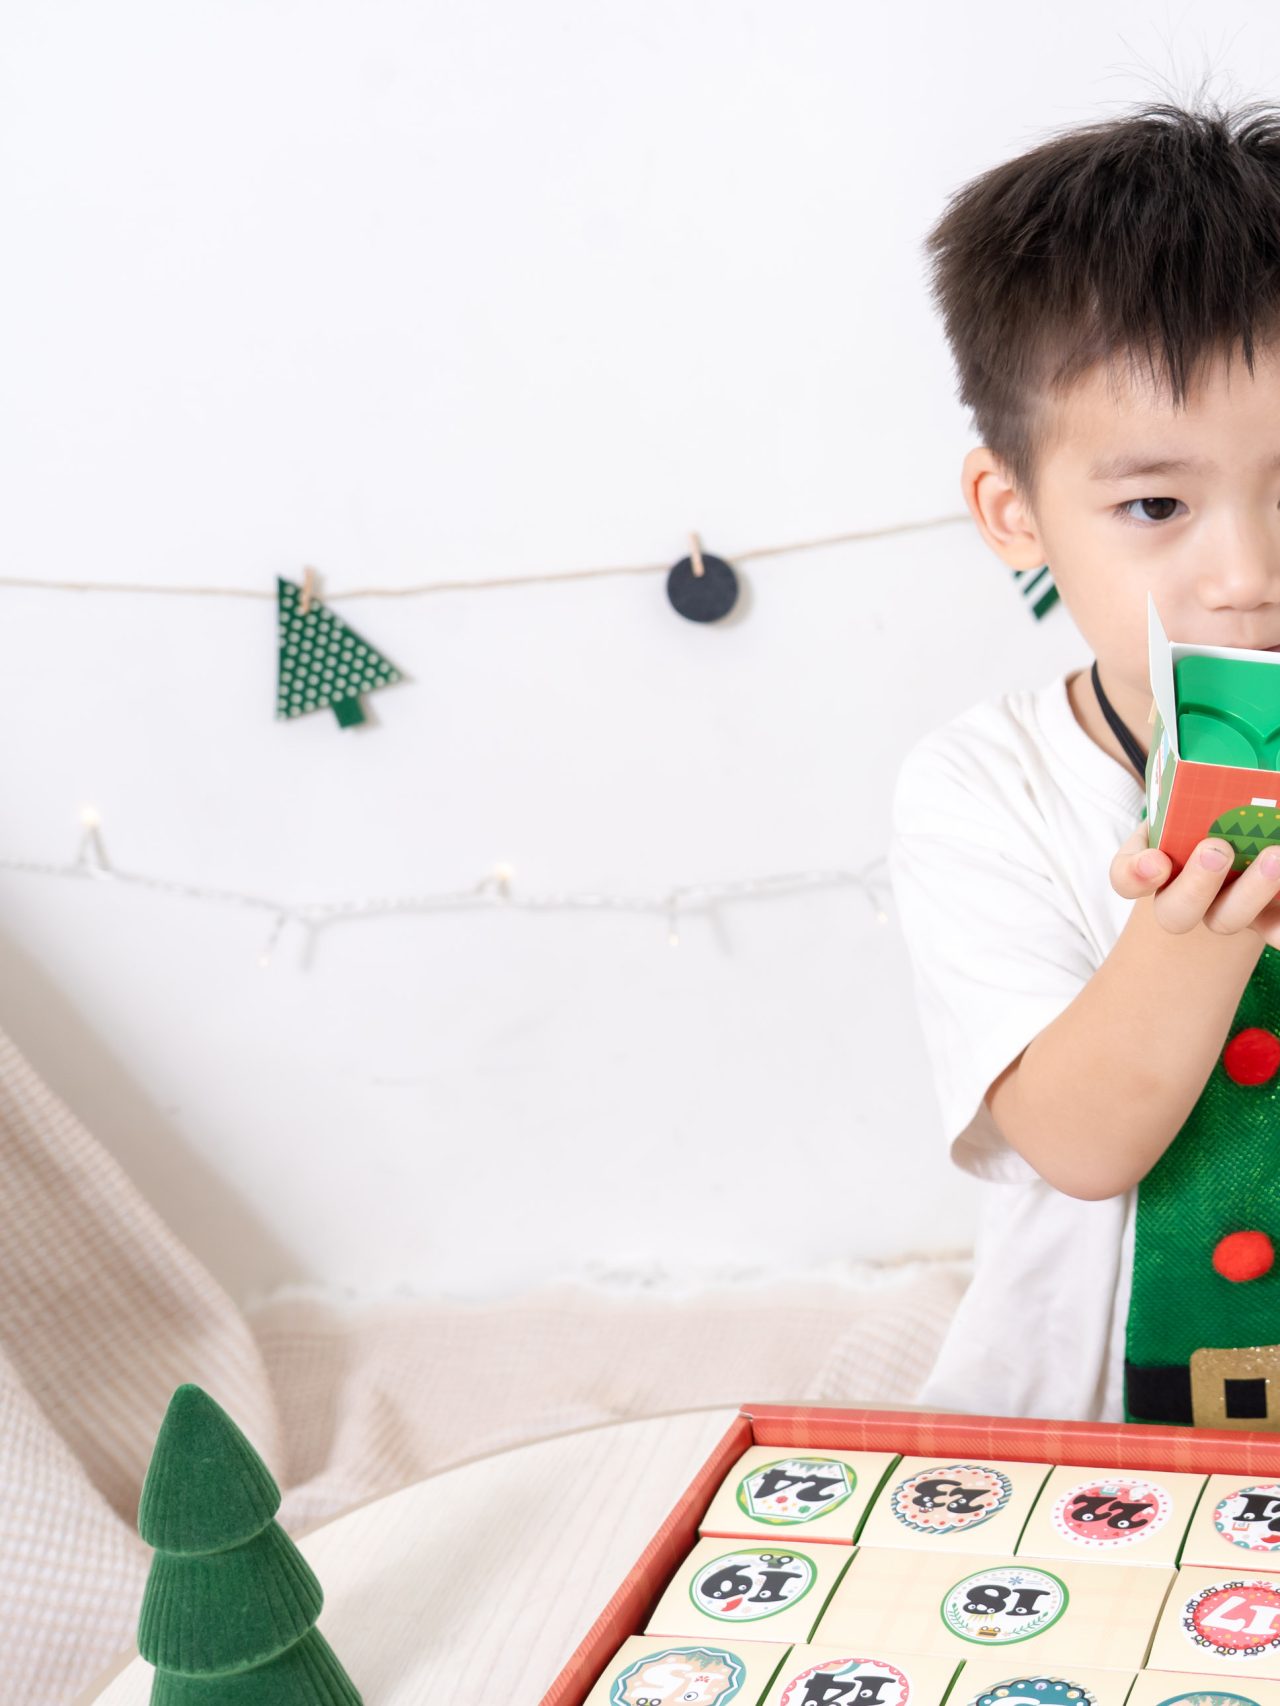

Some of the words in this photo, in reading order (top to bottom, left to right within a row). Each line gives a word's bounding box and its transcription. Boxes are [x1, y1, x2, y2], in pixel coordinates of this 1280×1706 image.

[754, 1469, 845, 1502] 24
[912, 1479, 992, 1514] 23
[1072, 1494, 1153, 1529] 22
[700, 1564, 802, 1603] 19
[962, 1584, 1051, 1616] 18
[630, 1663, 725, 1702] 15
